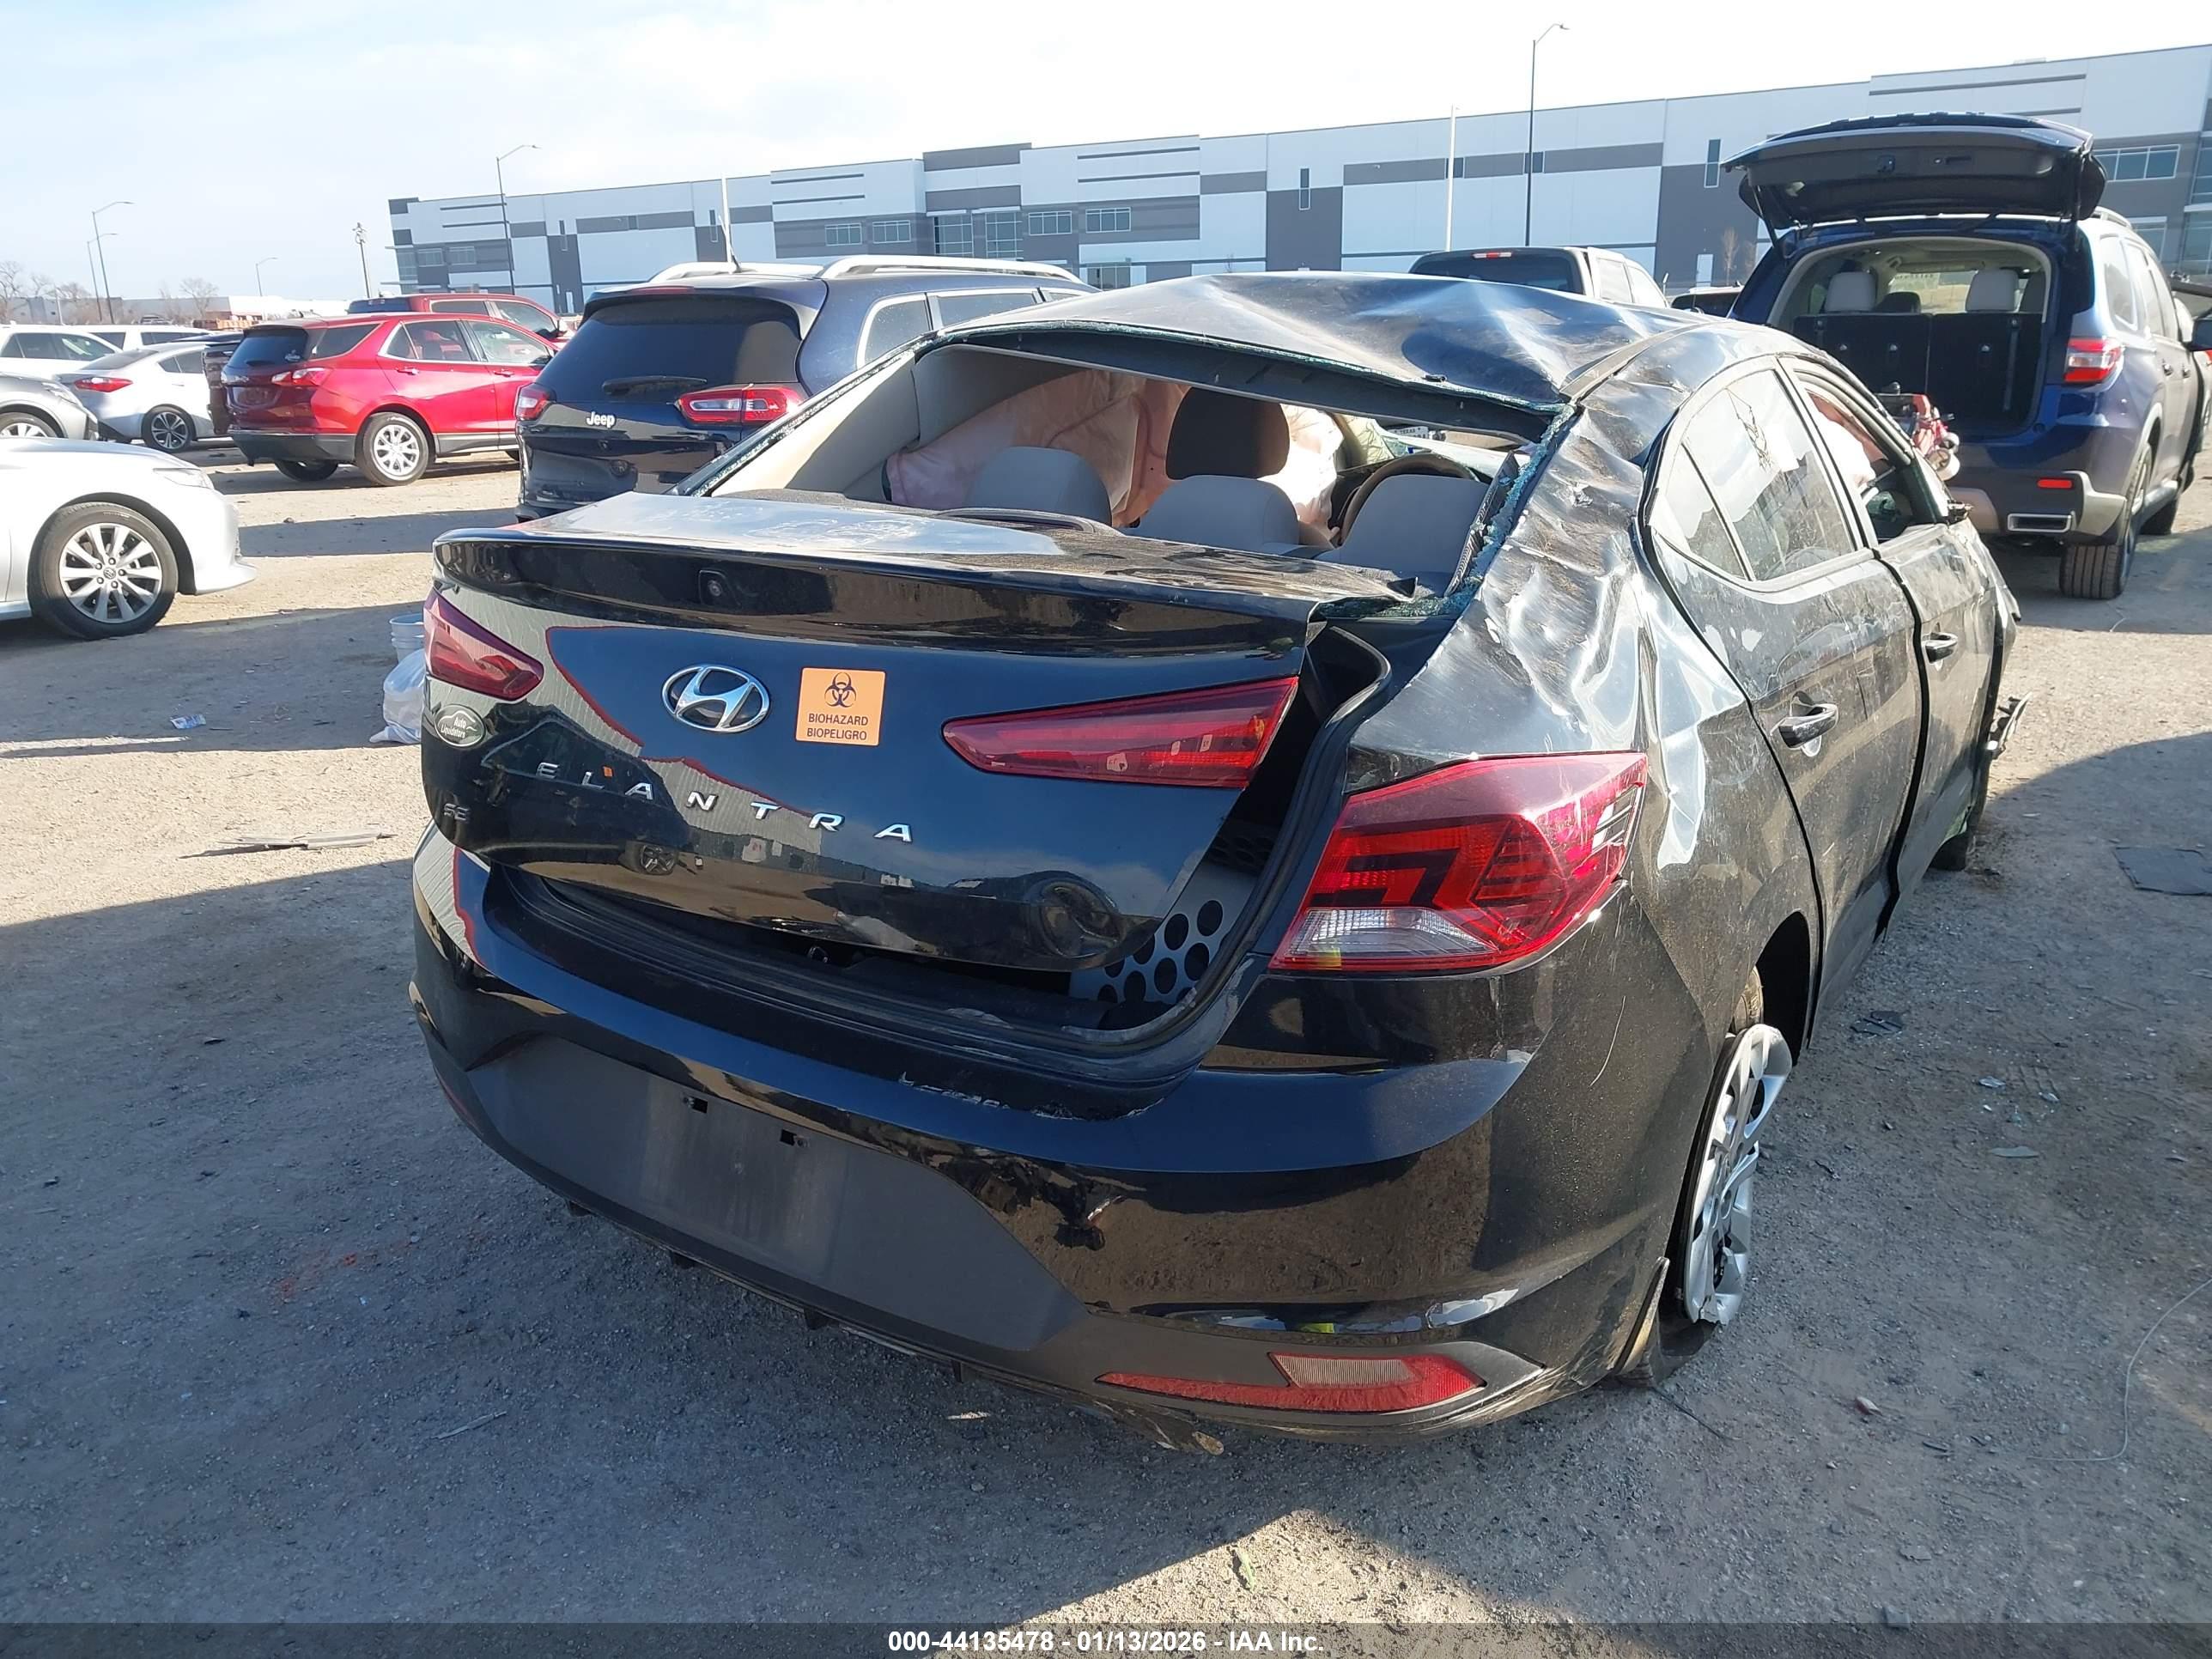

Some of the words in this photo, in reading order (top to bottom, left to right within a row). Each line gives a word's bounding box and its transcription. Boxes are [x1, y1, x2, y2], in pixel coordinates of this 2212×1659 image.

[586, 411, 616, 428] Jeep
[453, 717, 466, 728] Auto
[808, 713, 869, 726] BIOHAZARD
[441, 724, 465, 738] Liquidators
[806, 727, 867, 741] BIOPELIGRO
[535, 762, 915, 842] ELANTRA
[444, 803, 469, 821] SE
